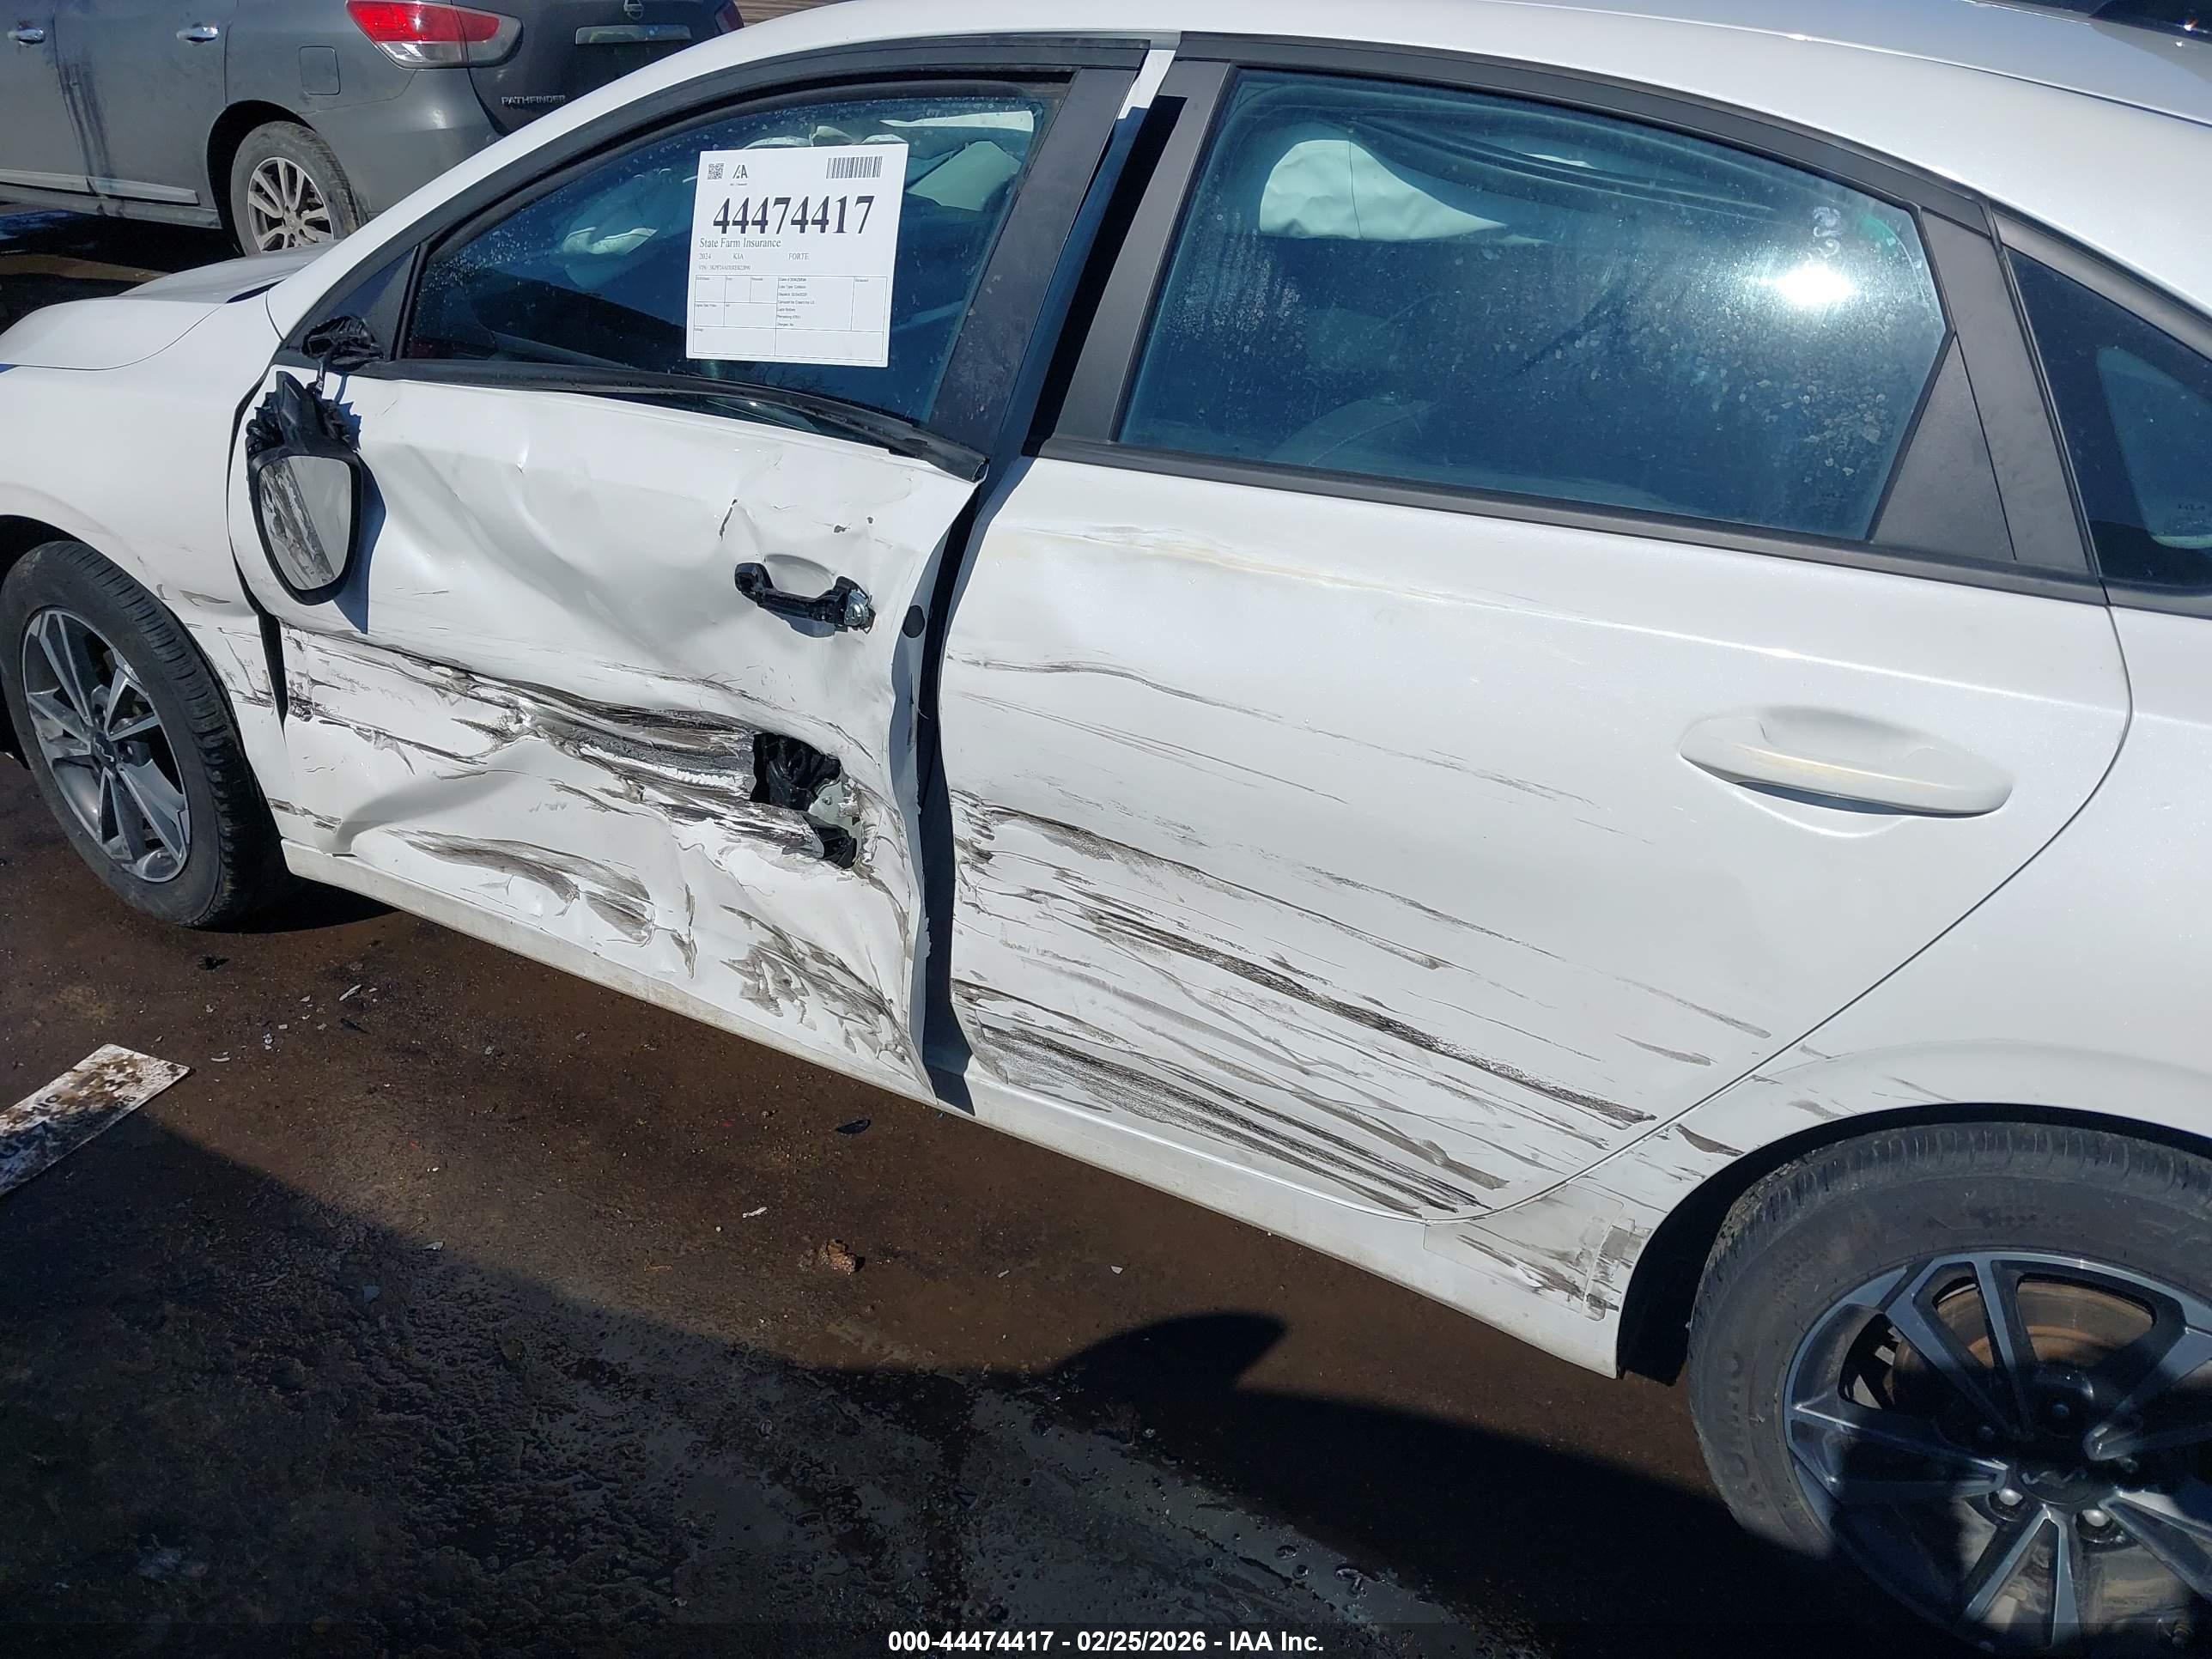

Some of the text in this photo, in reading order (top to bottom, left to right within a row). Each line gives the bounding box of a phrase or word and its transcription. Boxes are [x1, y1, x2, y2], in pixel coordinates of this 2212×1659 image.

[501, 94, 566, 105] PATHFINDER
[713, 196, 875, 234] 44474417
[699, 238, 781, 248] State Farm Insurance
